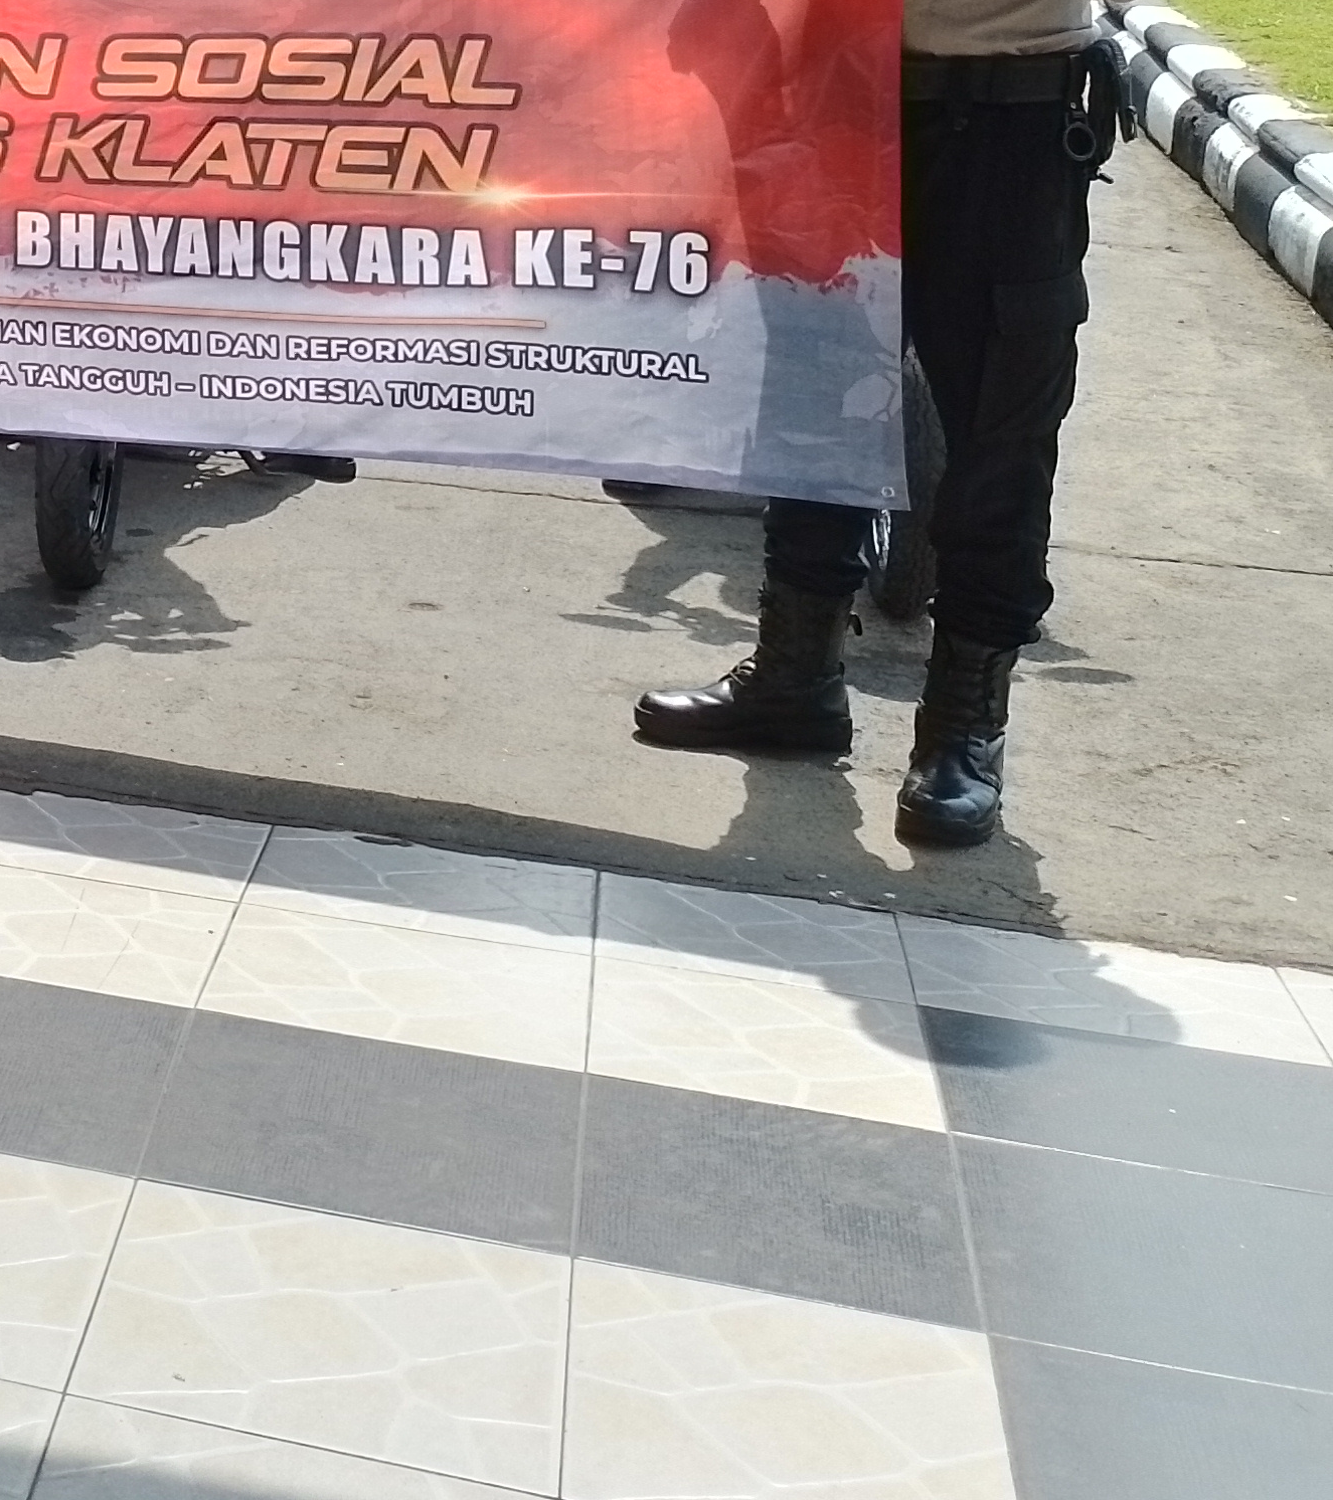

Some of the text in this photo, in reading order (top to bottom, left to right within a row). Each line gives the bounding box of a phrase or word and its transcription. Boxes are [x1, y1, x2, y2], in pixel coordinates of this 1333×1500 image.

[97, 32, 523, 107] SOSIAL
[36, 111, 499, 195] KLATEN
[16, 209, 490, 288] BHAYANGKARA
[513, 228, 712, 296] KE-76
[20, 361, 171, 398] TANGGUH
[199, 375, 383, 407] INDONESIA
[385, 379, 534, 417] TUMBUH
[52, 320, 201, 356] EKONOMI
[206, 332, 280, 361] DAN
[286, 335, 479, 367] REFORMASI
[484, 341, 710, 383] STRUKTURAL
